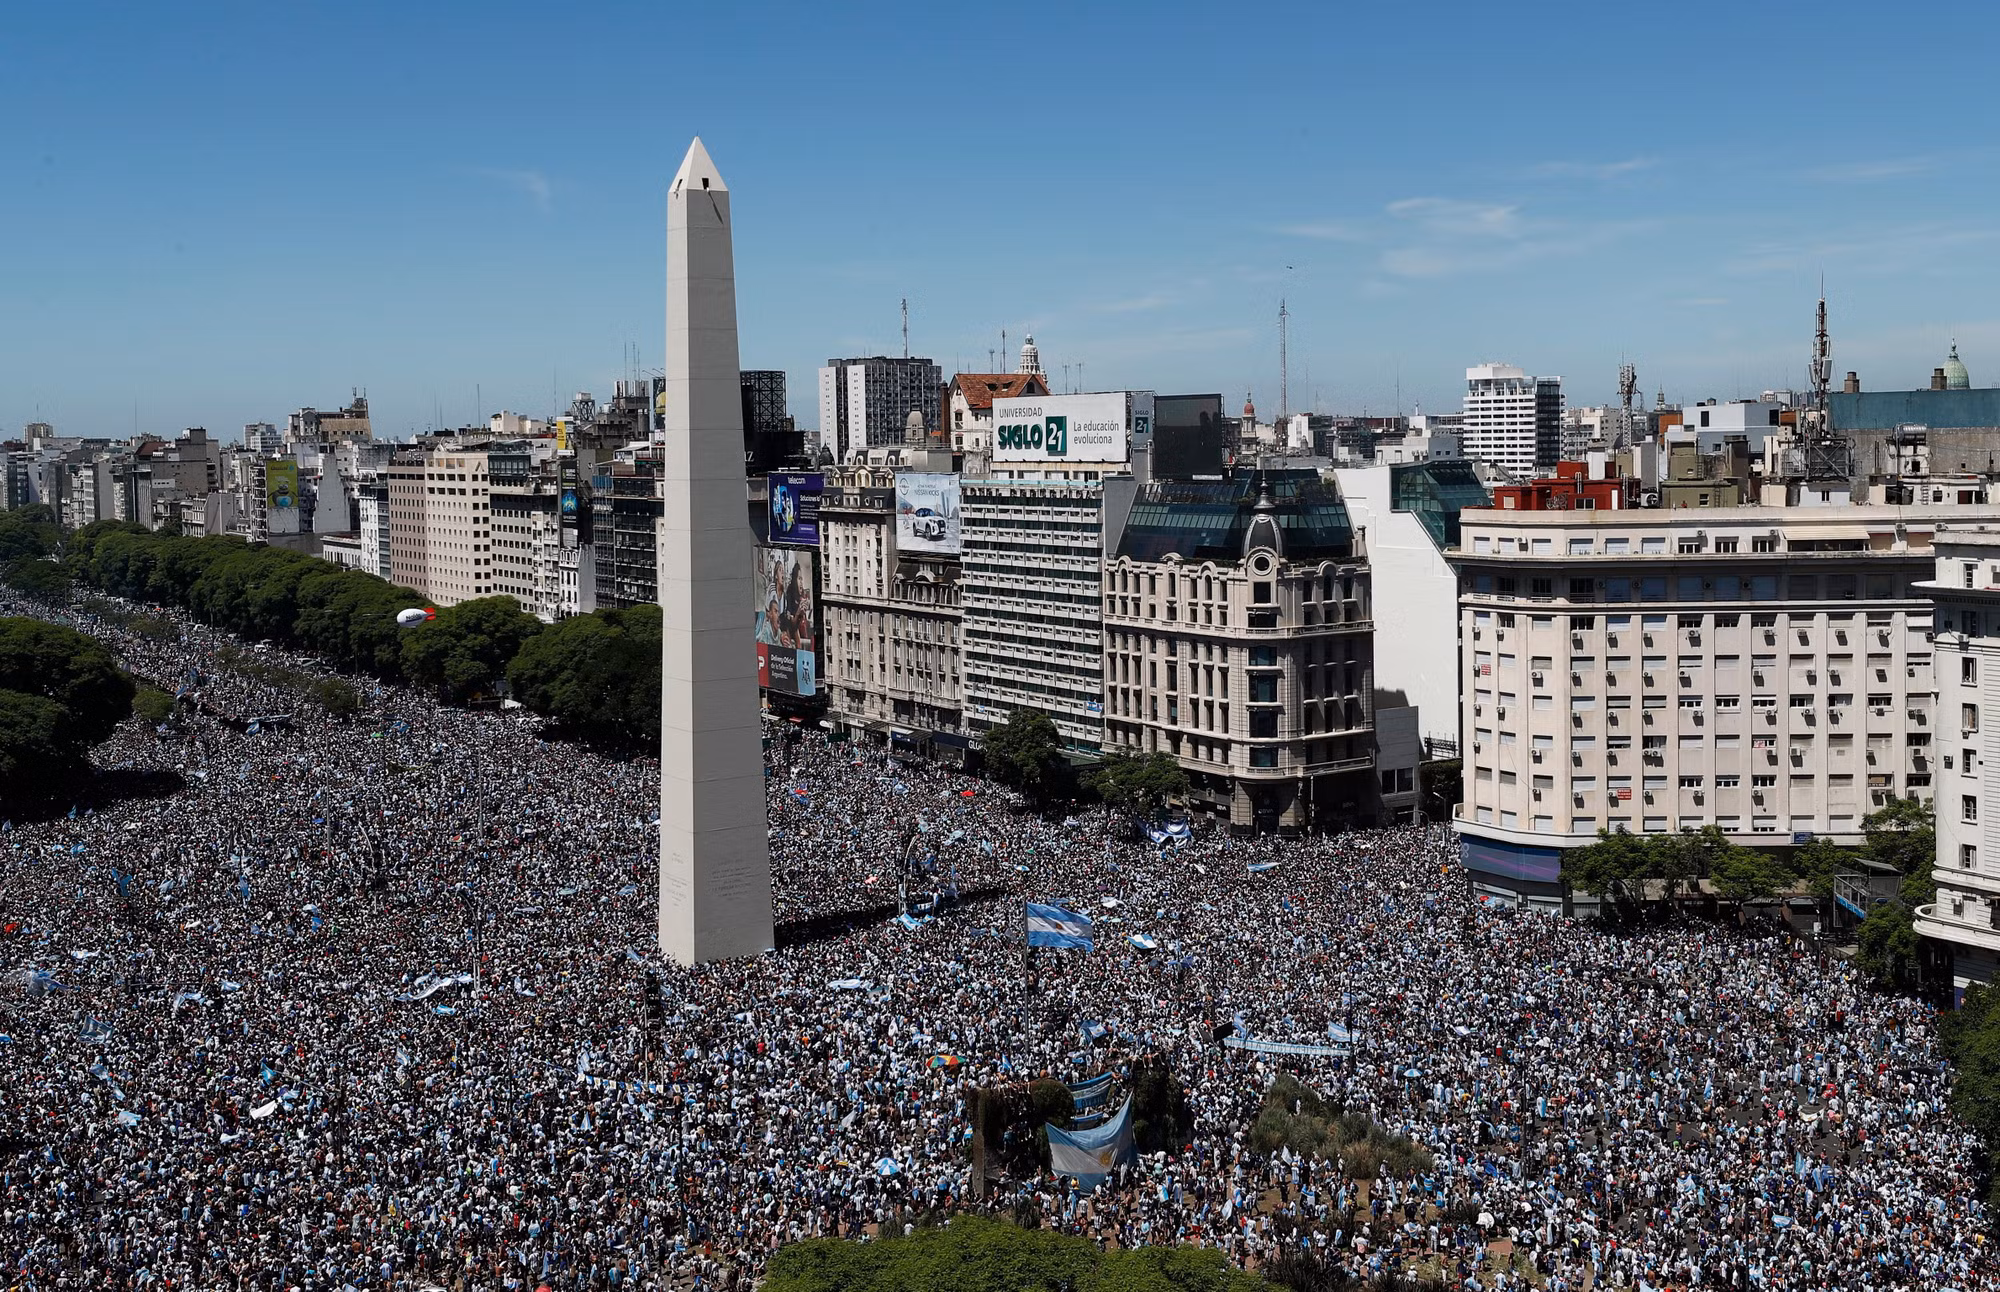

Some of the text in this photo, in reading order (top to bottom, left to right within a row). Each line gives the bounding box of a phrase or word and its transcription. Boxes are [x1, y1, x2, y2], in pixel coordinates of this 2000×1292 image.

[999, 407, 1043, 418] UNIVERSIDAD
[1074, 420, 1119, 432] La educación
[1136, 420, 1148, 433] 21
[998, 422, 1063, 451] SIGLO 21
[1074, 433, 1112, 444] evoluciona
[788, 476, 806, 484] telecom
